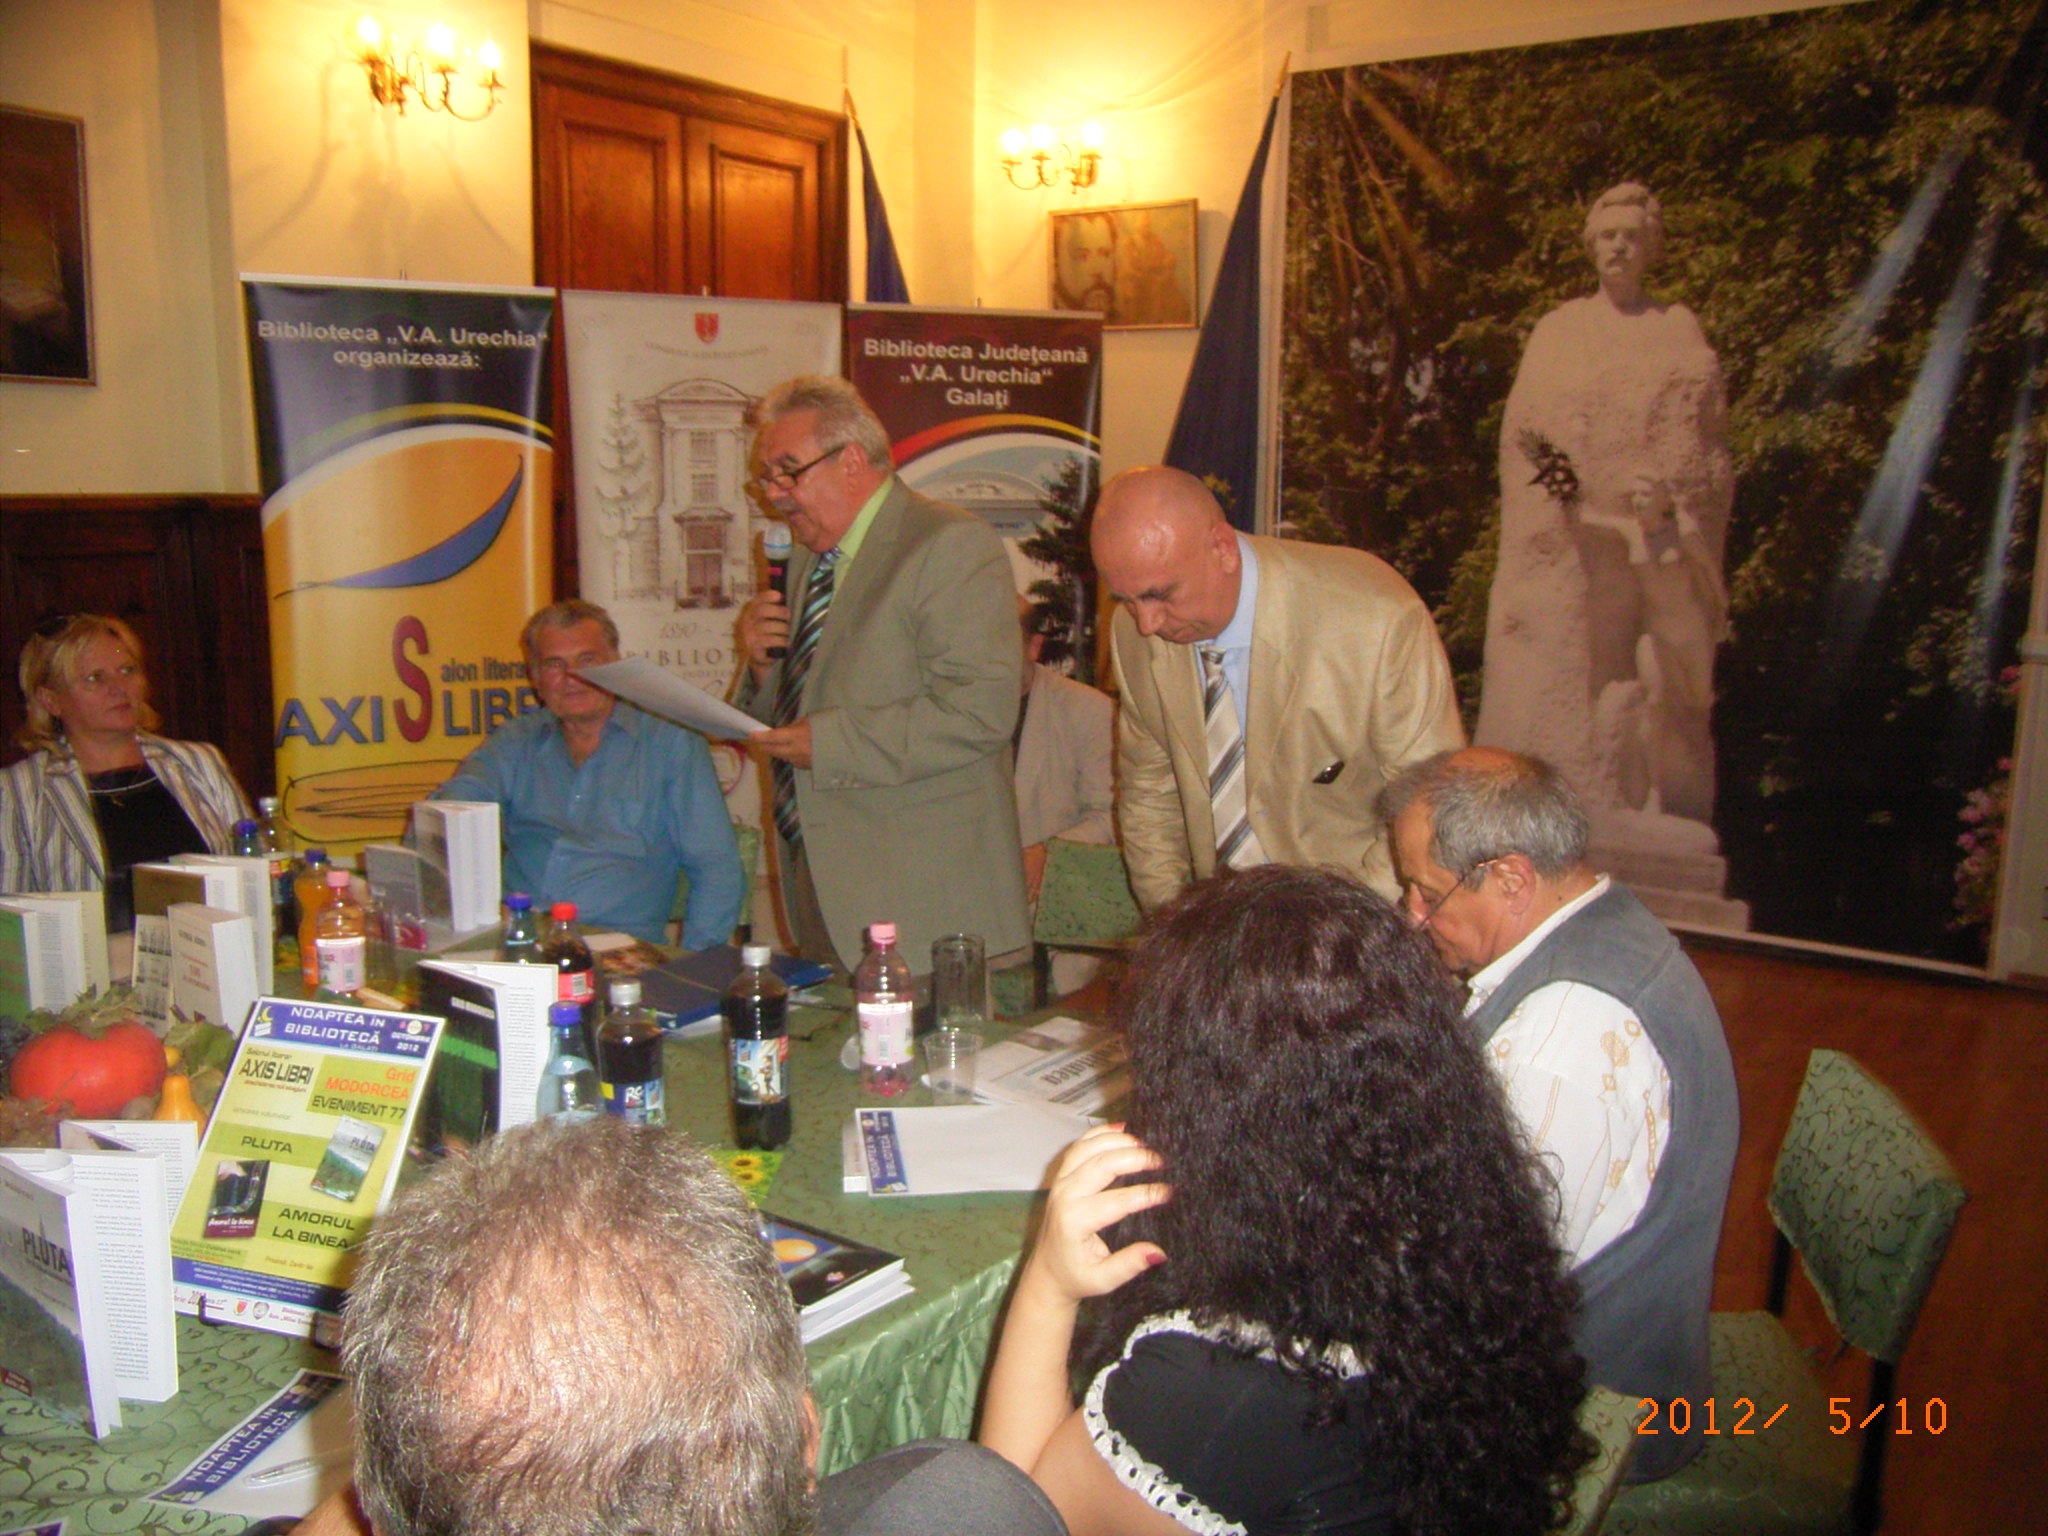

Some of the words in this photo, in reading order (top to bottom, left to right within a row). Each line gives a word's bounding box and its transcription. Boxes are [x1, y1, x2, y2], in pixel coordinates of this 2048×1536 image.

[258, 320, 379, 342] Biblioteca
[333, 348, 481, 370] organizează:
[864, 338, 973, 359] Biblioteca
[979, 343, 1088, 365] Judeţeană
[946, 388, 1009, 410] Galaţi
[291, 1007, 362, 1025] NOAPTEA
[284, 1022, 380, 1045] BIBLIOTECĂ
[239, 1058, 277, 1080] AXIS
[276, 1063, 314, 1085] LIBRI
[386, 1067, 416, 1084] Grid
[325, 1077, 410, 1100] MODORCEA
[312, 1096, 387, 1118] EVENIMENT
[241, 1136, 293, 1154] PLUTA
[279, 1208, 355, 1231] AMORUL
[272, 1226, 294, 1241] LA
[298, 1231, 349, 1249] BINEA
[22, 1227, 72, 1279] PLUTA
[187, 1422, 262, 1481] NOAPTEA
[205, 1409, 298, 1484] BIBLIOTECĂ
